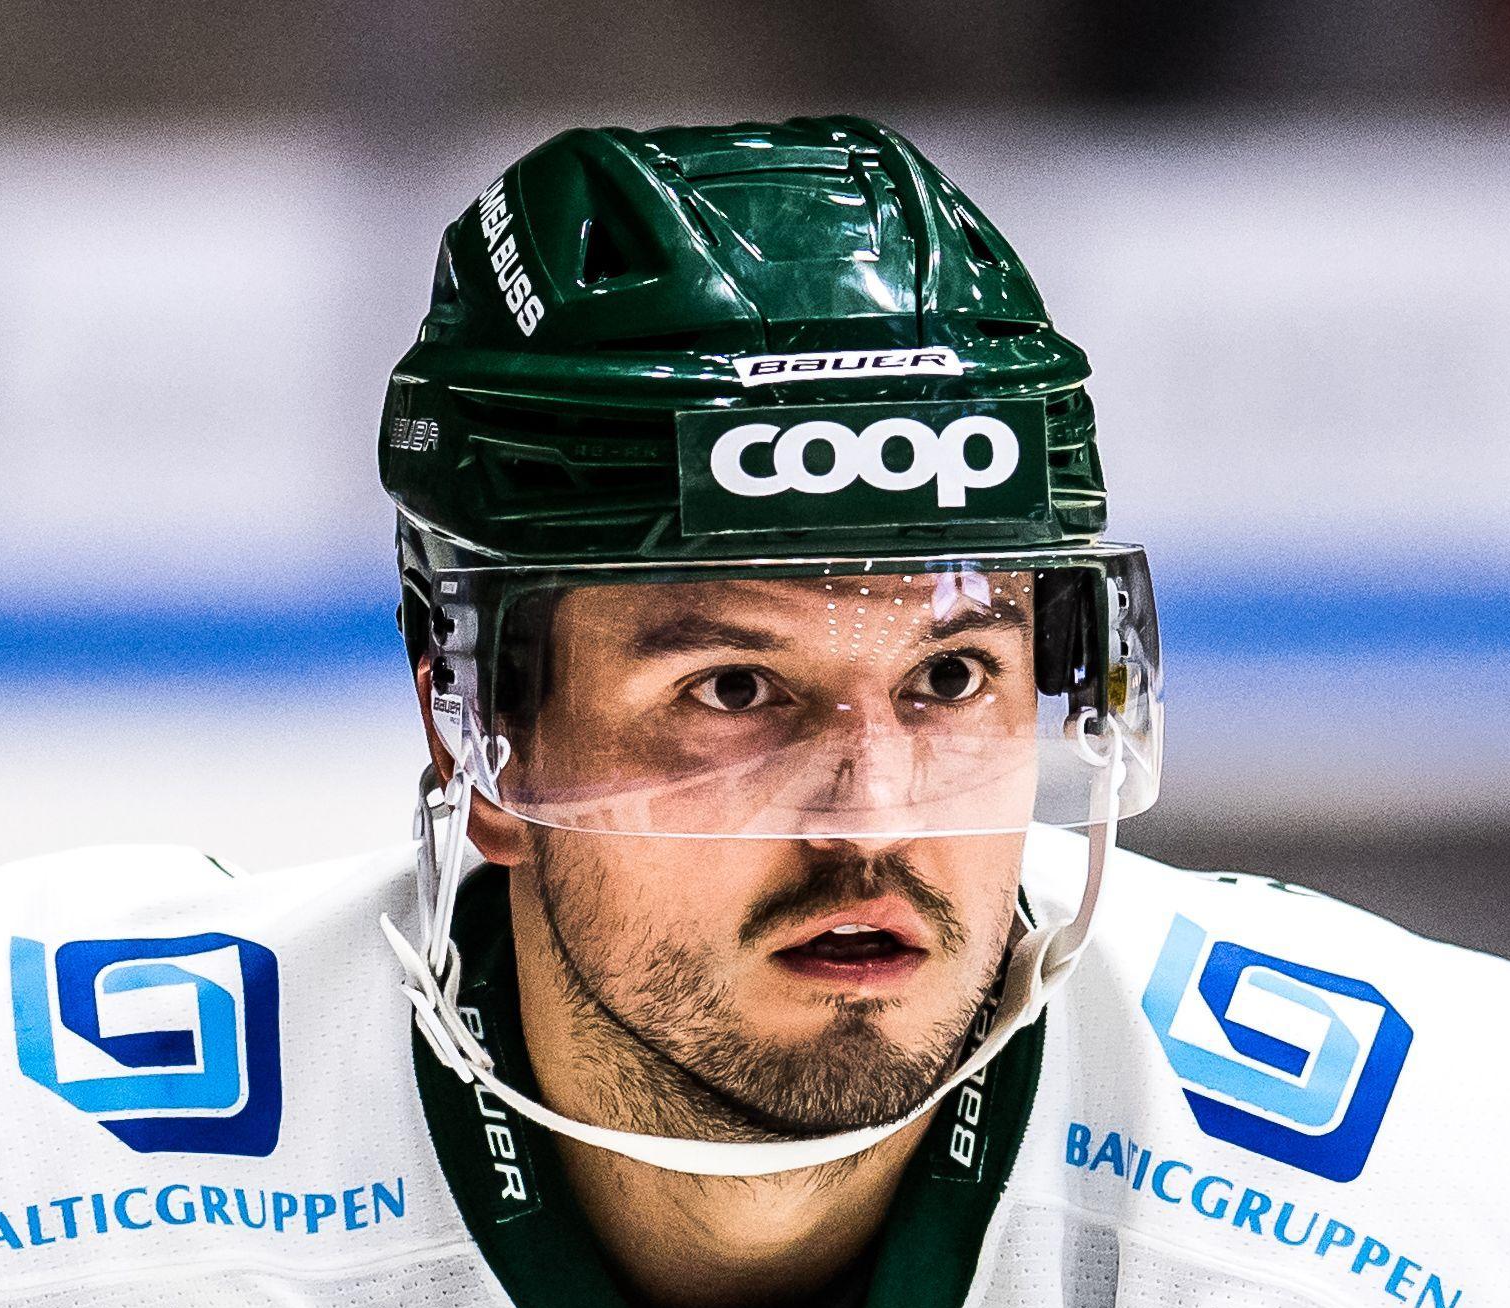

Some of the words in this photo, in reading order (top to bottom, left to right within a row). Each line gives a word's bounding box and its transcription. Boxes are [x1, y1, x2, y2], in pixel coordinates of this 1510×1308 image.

[490, 233, 545, 337] BUSS
[710, 415, 1020, 508] coop
[459, 1006, 527, 1201] BUER
